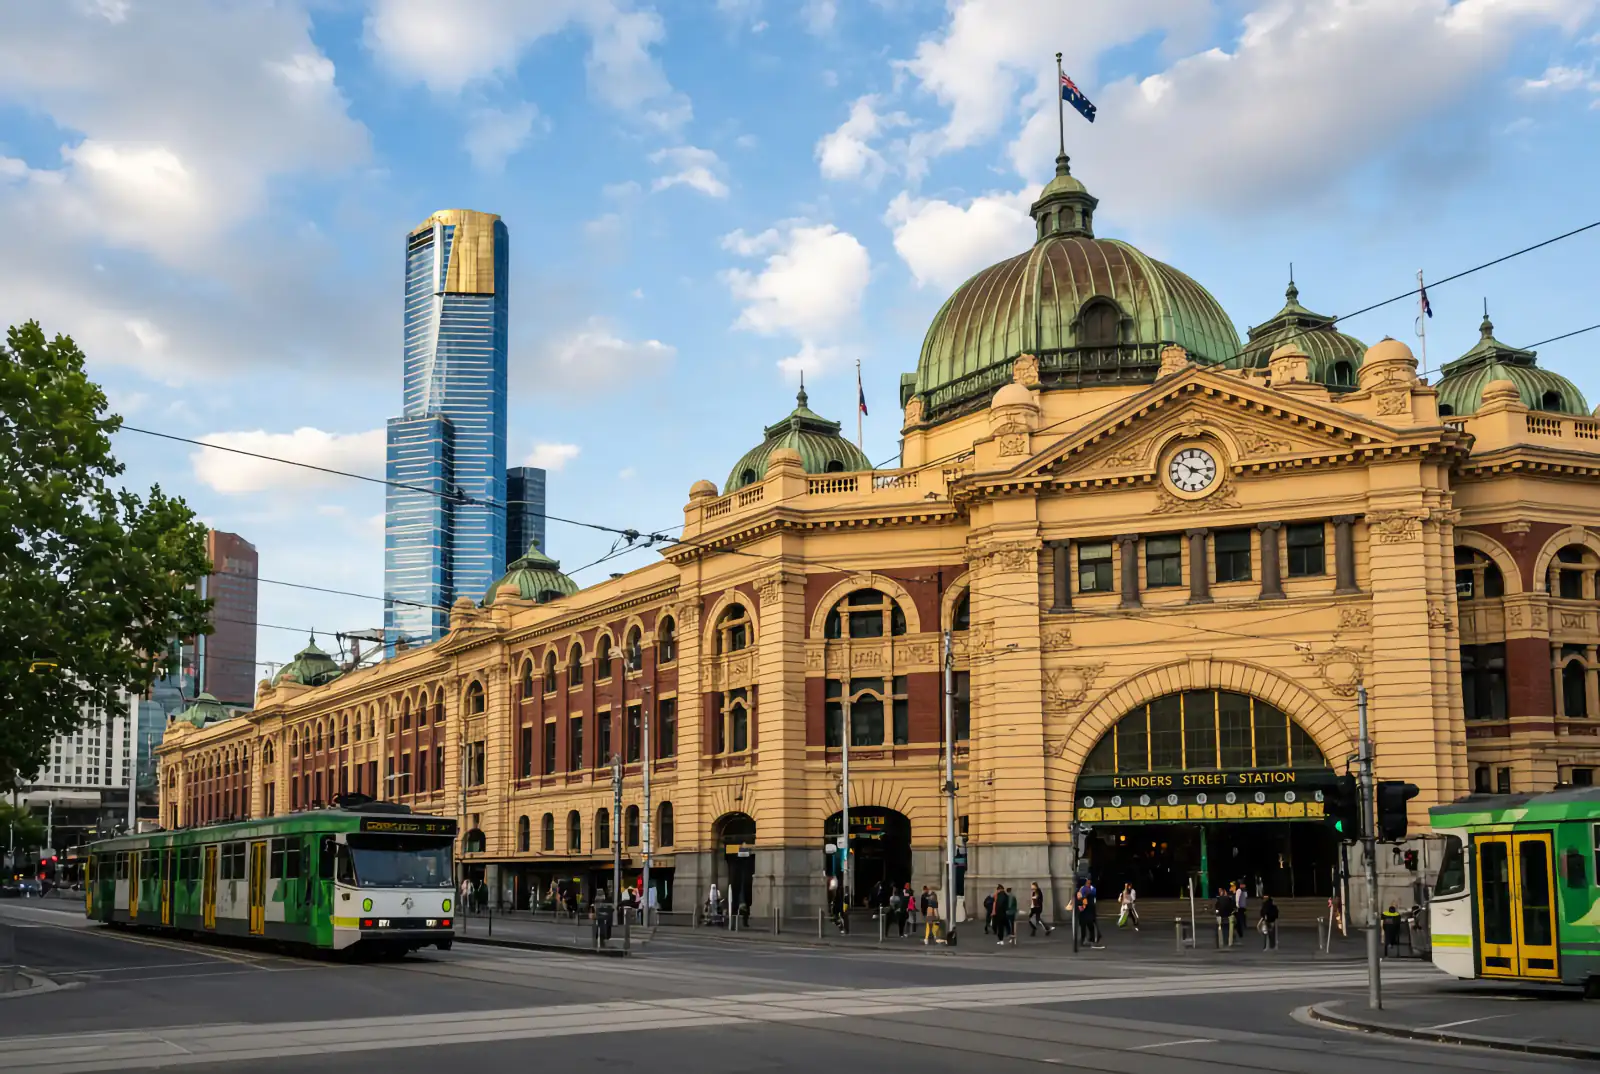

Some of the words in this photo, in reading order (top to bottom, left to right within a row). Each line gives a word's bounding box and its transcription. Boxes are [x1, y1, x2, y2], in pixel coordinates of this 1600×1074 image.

[1113, 775, 1172, 788] FLINDERS
[1183, 773, 1228, 785] STREET
[1239, 772, 1296, 784] STATION
